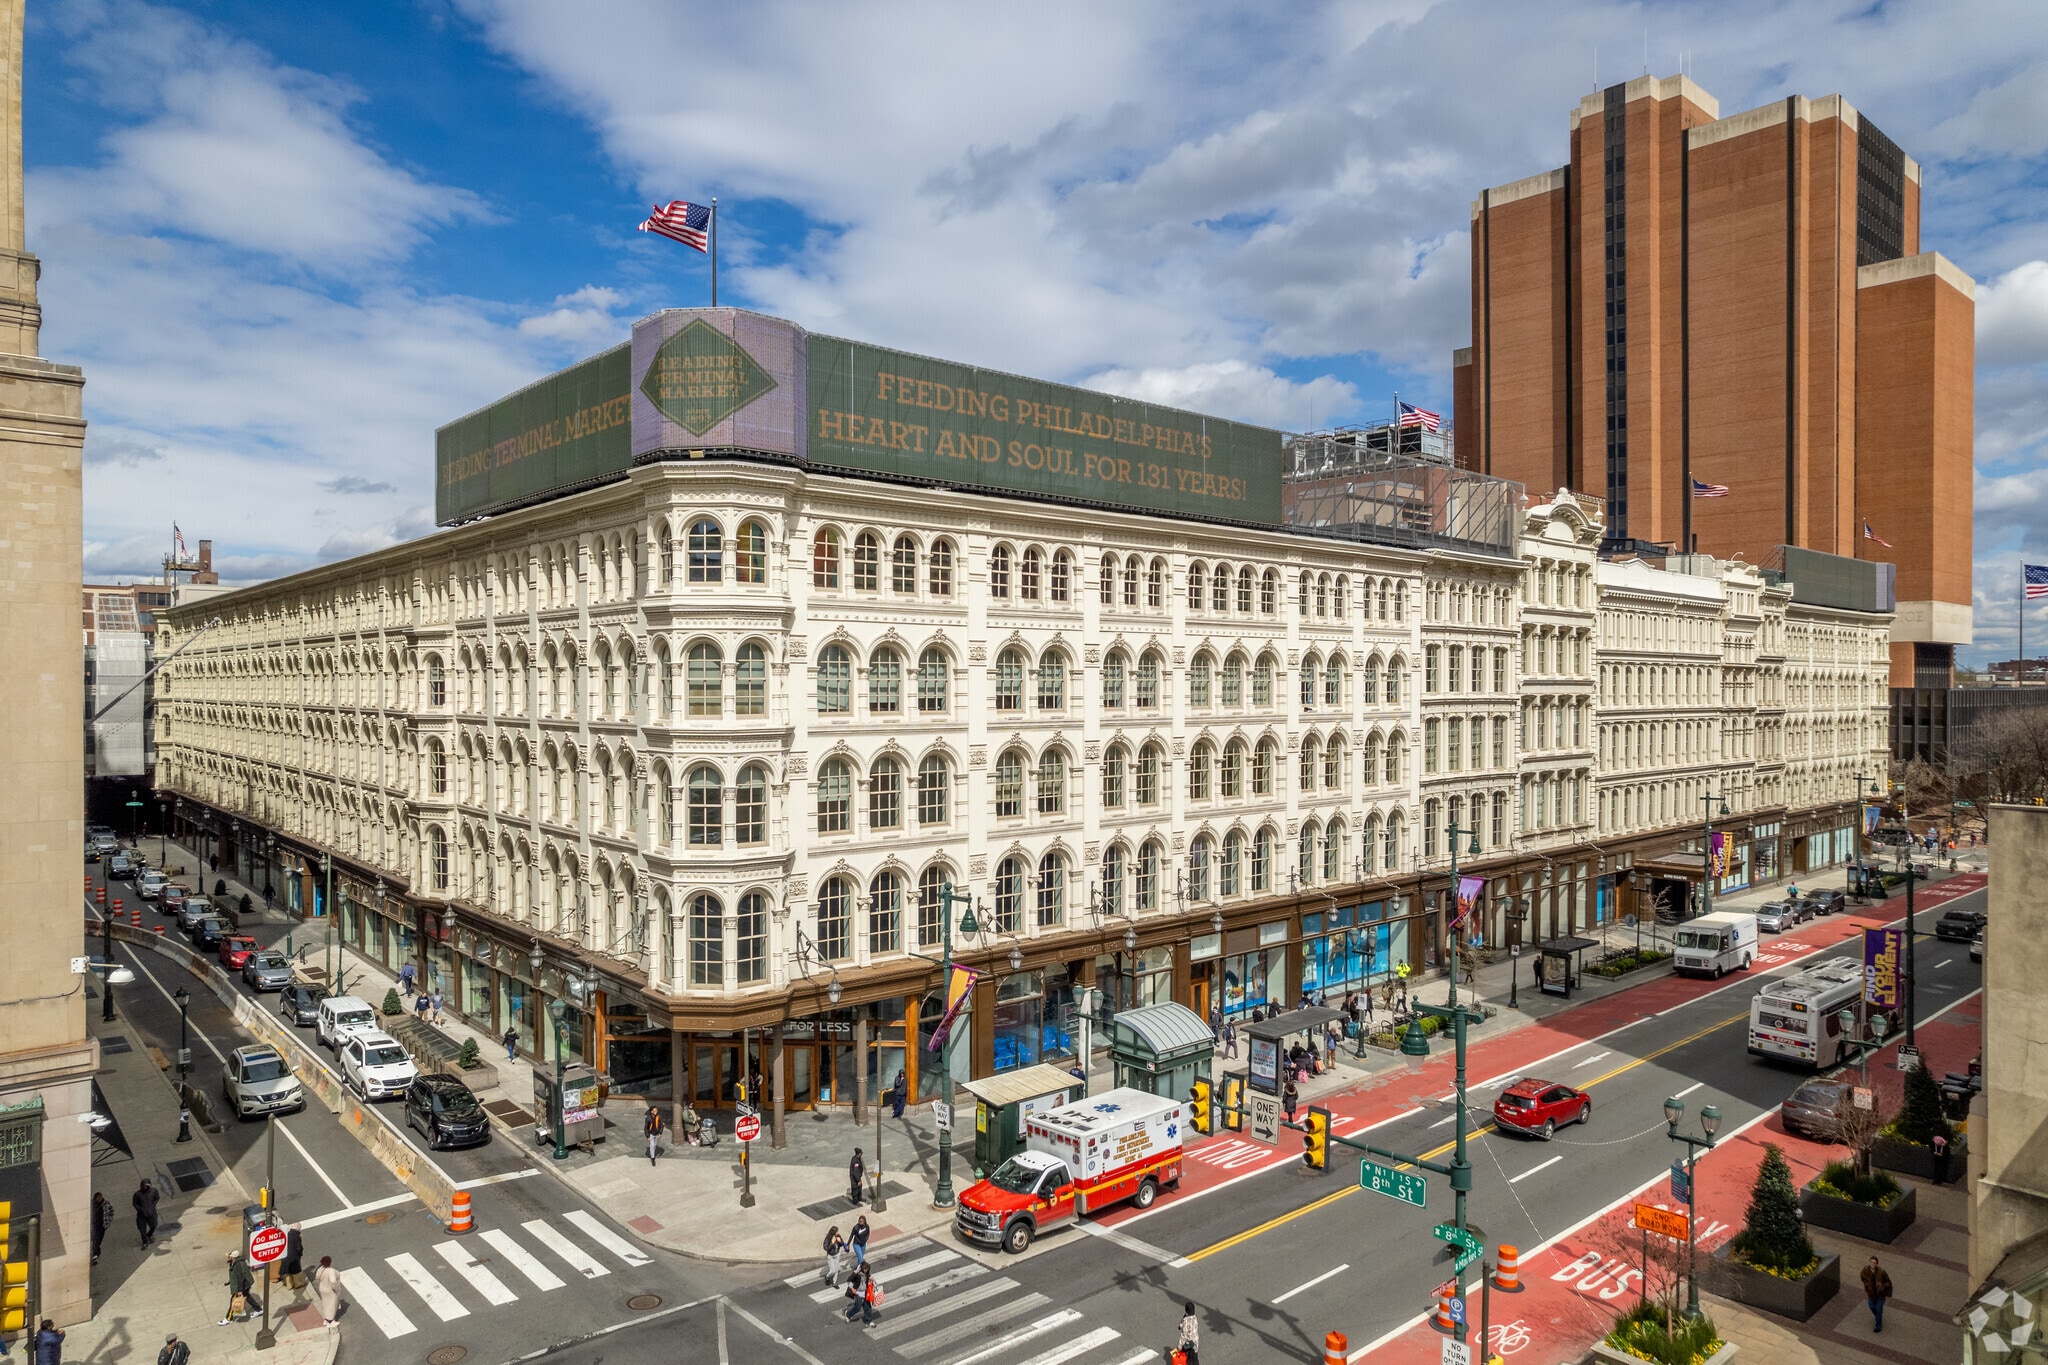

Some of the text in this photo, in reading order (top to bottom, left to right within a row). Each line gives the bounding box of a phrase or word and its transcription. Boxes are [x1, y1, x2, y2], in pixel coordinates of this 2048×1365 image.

[657, 355, 743, 371] READING
[654, 370, 749, 386] TERMINAL
[657, 384, 742, 399] MARKET
[877, 372, 1212, 459] FEEDING PHILADELPHIA'S
[493, 419, 563, 469] TERMINAL
[565, 393, 632, 443] MARKET
[818, 408, 1247, 502] HEART AND SOUL FOR 131 YEARS!
[1771, 943, 1811, 952] BUS
[1874, 953, 1887, 998] YOUR
[1884, 931, 1897, 1005] ELEMENT
[1865, 965, 1876, 1003] FIND
[790, 1021, 850, 1032] FOR LESS
[937, 1104, 947, 1112] ONE
[1256, 1101, 1275, 1115] ONE
[1255, 1112, 1275, 1126] WAY
[1183, 1138, 1273, 1170] ONLY
[1372, 1176, 1414, 1201] 8th St
[1653, 1211, 1669, 1222] END
[1640, 1216, 1683, 1236] ROAD WORK
[255, 1231, 282, 1244] DO NOT
[1445, 1230, 1476, 1250] 8th St
[257, 1247, 280, 1258] ENTER
[1550, 1250, 1643, 1299] BUS
[1451, 1342, 1462, 1352] NO
[1446, 1348, 1467, 1363] TURN
